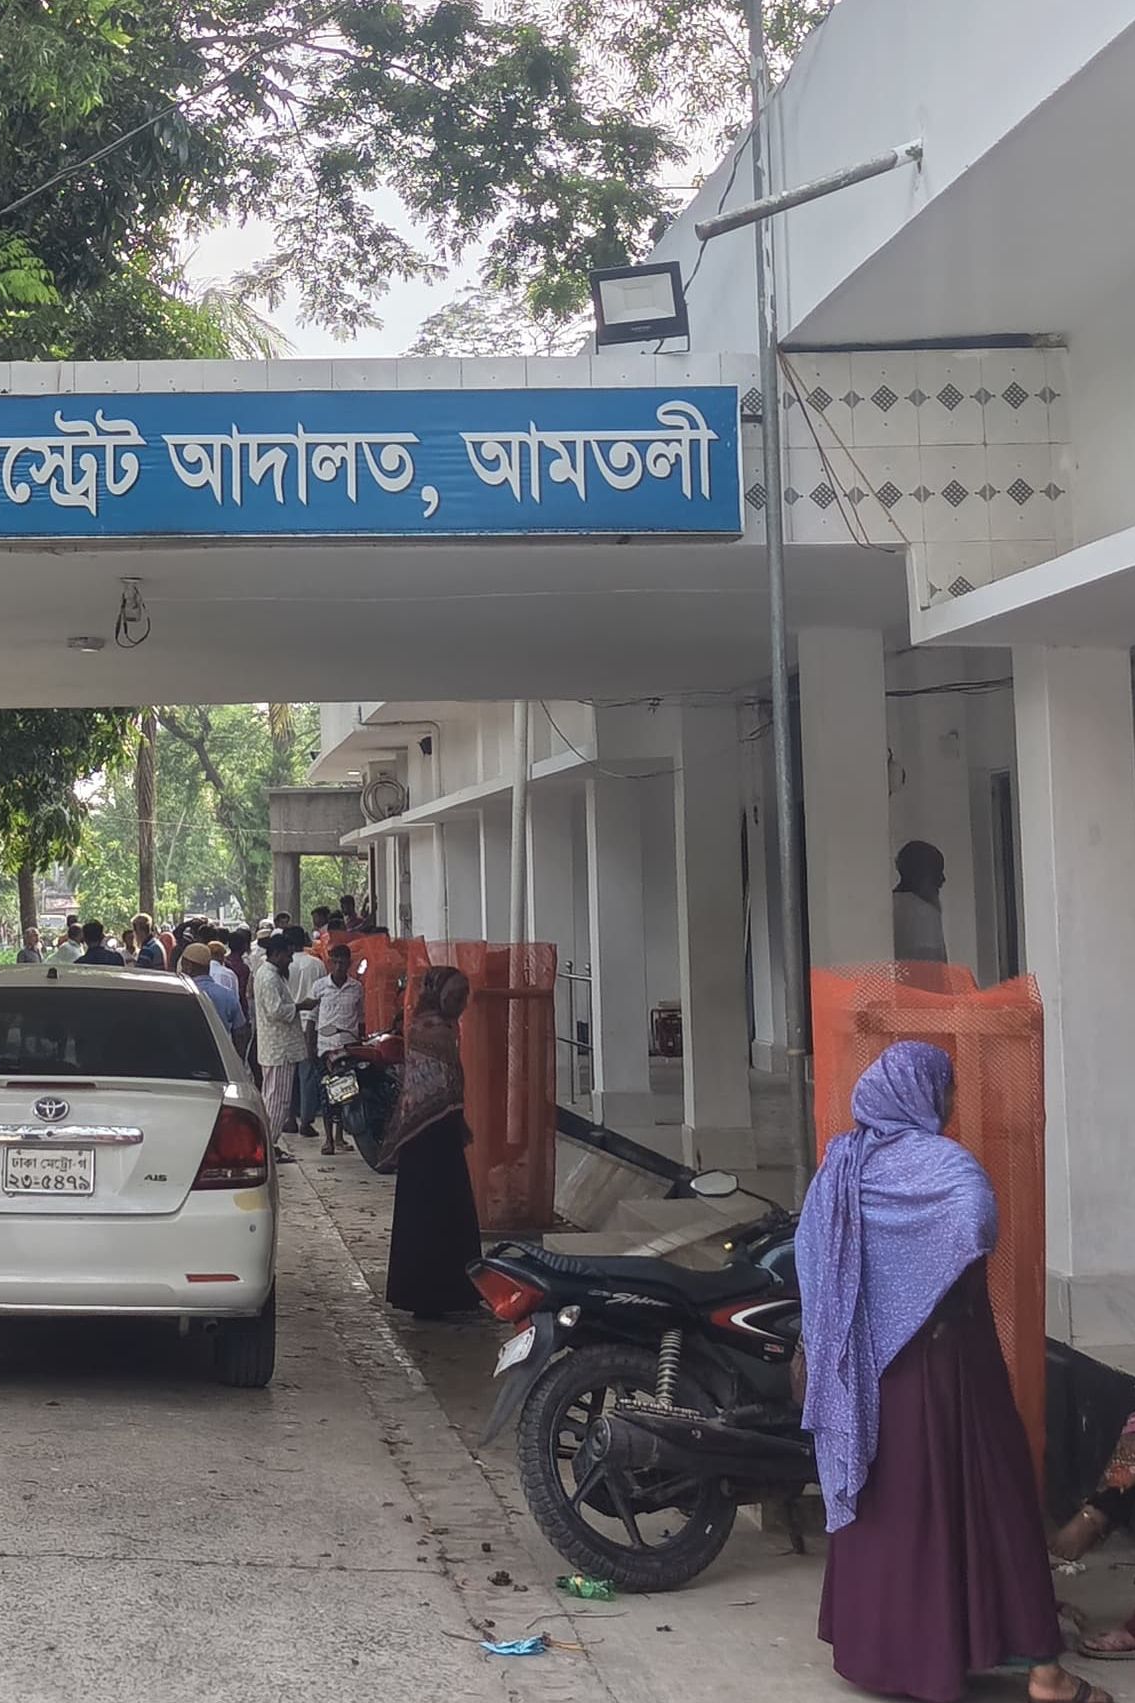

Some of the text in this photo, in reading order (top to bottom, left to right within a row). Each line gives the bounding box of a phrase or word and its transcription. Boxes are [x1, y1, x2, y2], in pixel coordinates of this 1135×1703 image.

[161, 422, 440, 518] আদালত,
[459, 400, 720, 503] আমতলী
[11, 1157, 37, 1169] ঢাকা
